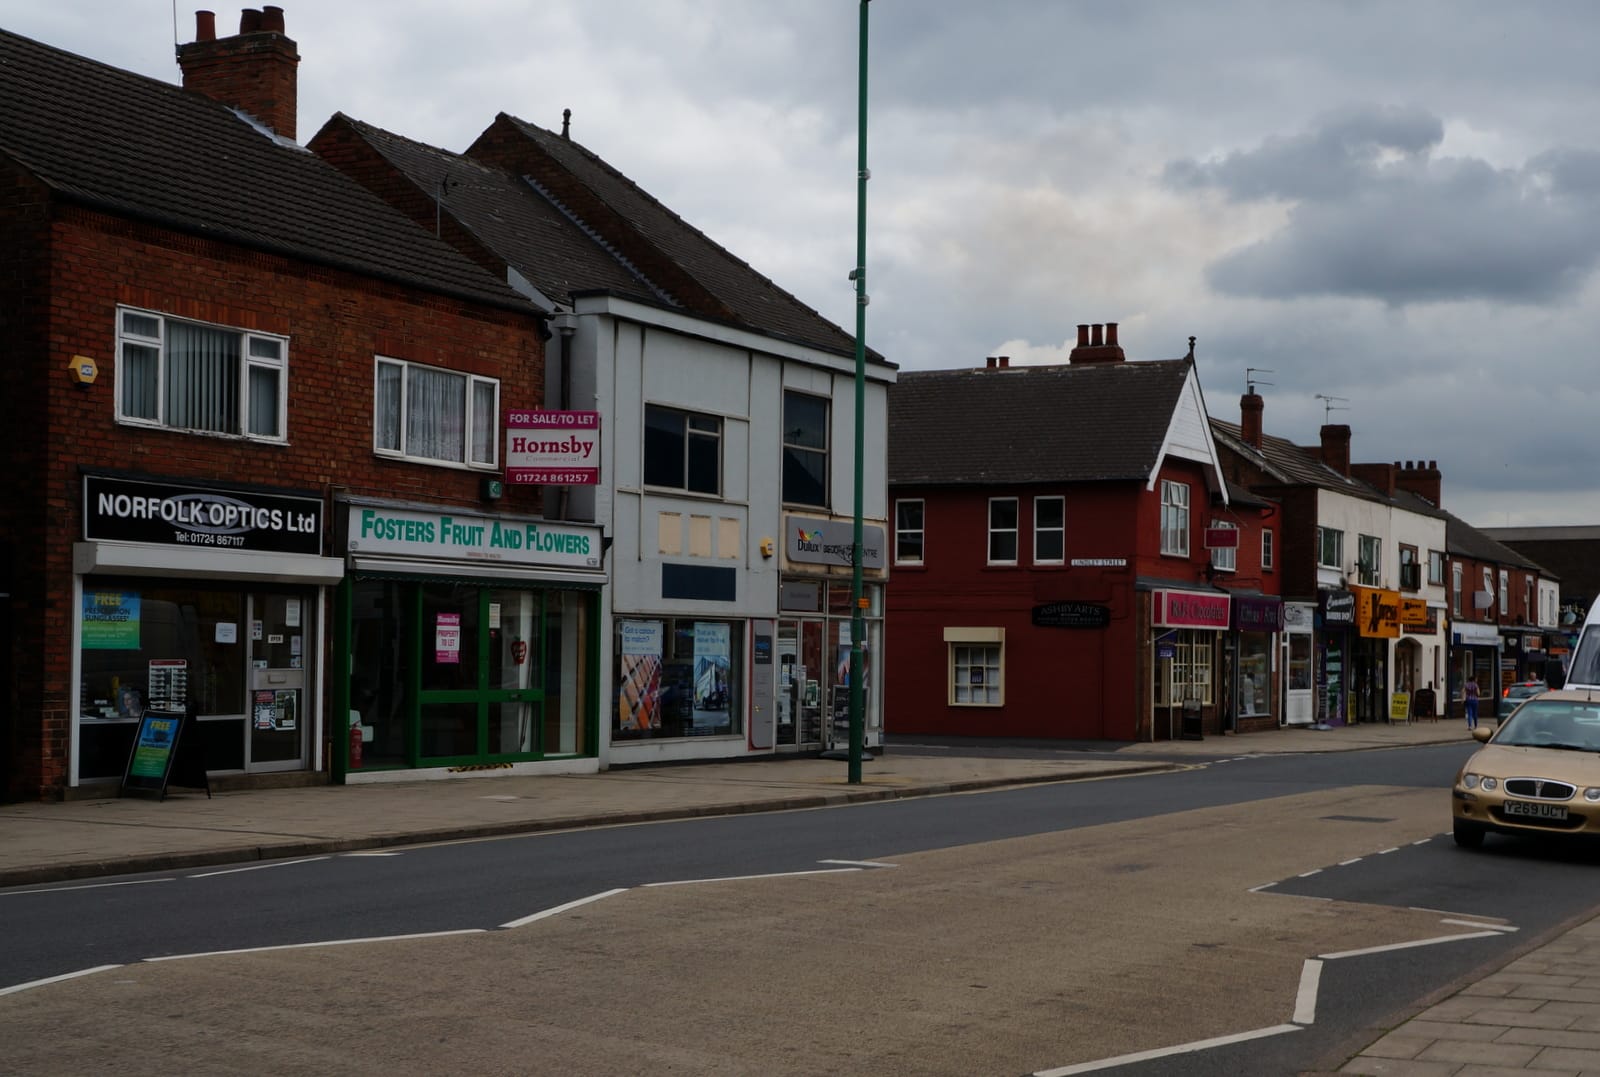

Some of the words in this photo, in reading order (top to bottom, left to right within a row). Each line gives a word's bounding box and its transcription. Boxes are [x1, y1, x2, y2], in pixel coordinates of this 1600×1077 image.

[510, 414, 530, 423] FOR
[532, 414, 574, 424] SALE/TO
[578, 415, 594, 424] LET
[512, 435, 594, 458] Hornsby
[550, 474, 588, 482] 861257
[98, 492, 202, 524] NORFOLK
[209, 504, 283, 529] OPTICS
[287, 511, 316, 534] Ltd
[175, 531, 190, 543] Tel:
[190, 532, 214, 545] 01724
[217, 535, 245, 547] 867117
[361, 510, 435, 543] FOSTERS
[440, 517, 484, 547] FRUIT
[490, 522, 522, 550] AND
[526, 525, 590, 555] FLOWERS
[798, 539, 819, 552] Dulux
[95, 592, 121, 606] FREE
[1075, 603, 1100, 615] ARTS
[1507, 802, 1539, 814] Y269
[1542, 804, 1566, 817] UCT
